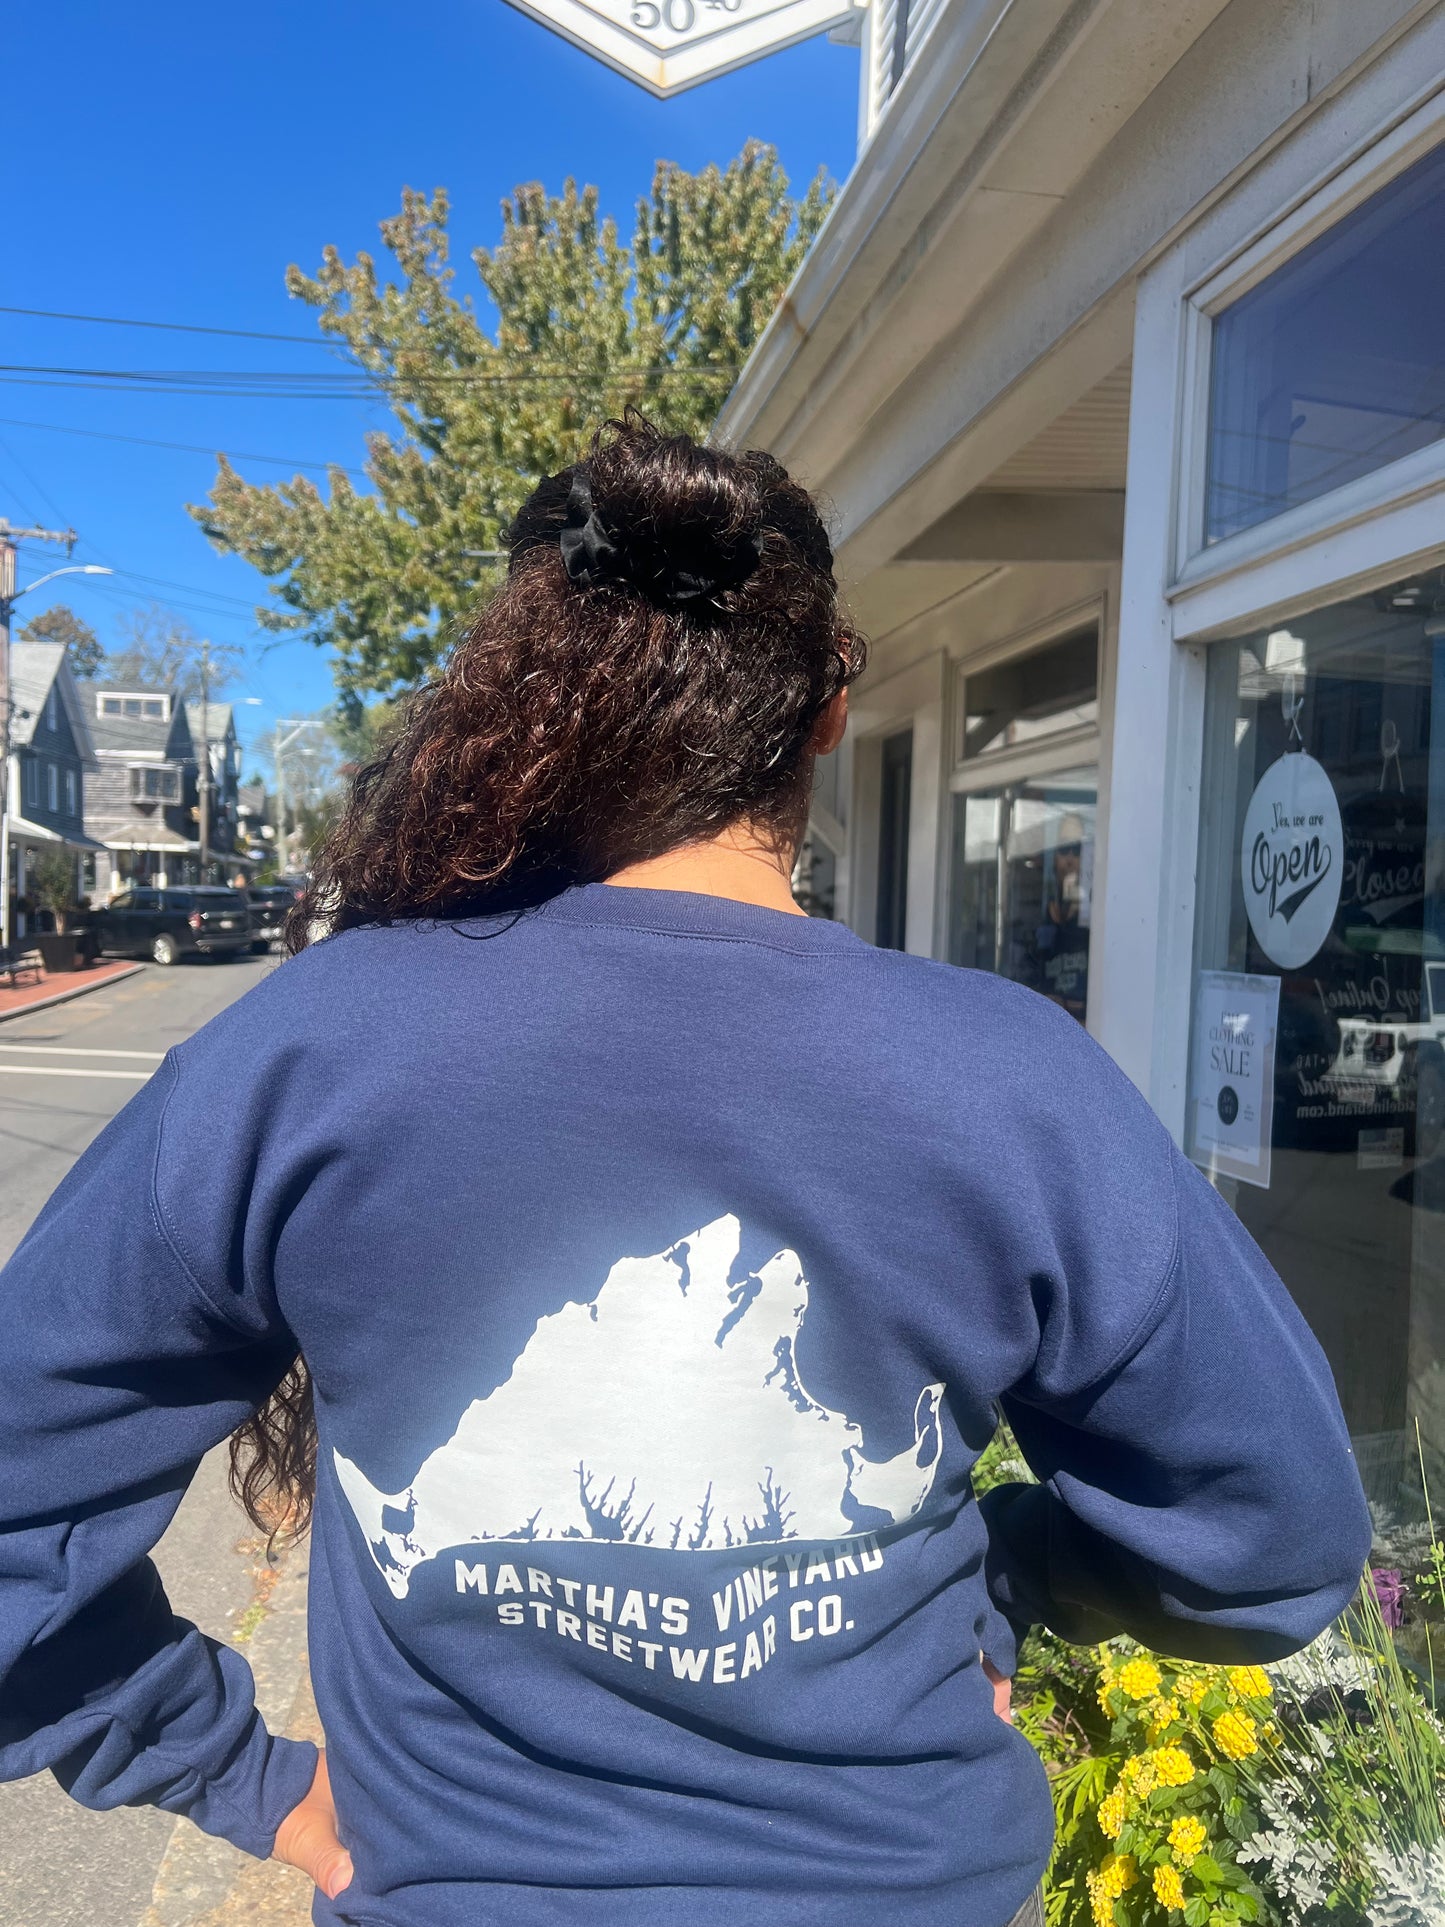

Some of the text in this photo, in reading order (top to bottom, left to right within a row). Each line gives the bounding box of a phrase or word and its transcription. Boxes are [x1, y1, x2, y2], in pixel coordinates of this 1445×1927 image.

[1292, 814, 1306, 828] we
[1308, 813, 1325, 827] are
[1252, 831, 1331, 919] Open
[1210, 1046, 1250, 1078] SALE
[455, 1533, 885, 1636] MARTHA'S VINEYARD
[497, 1594, 855, 1685] STREETWEAR CO.
